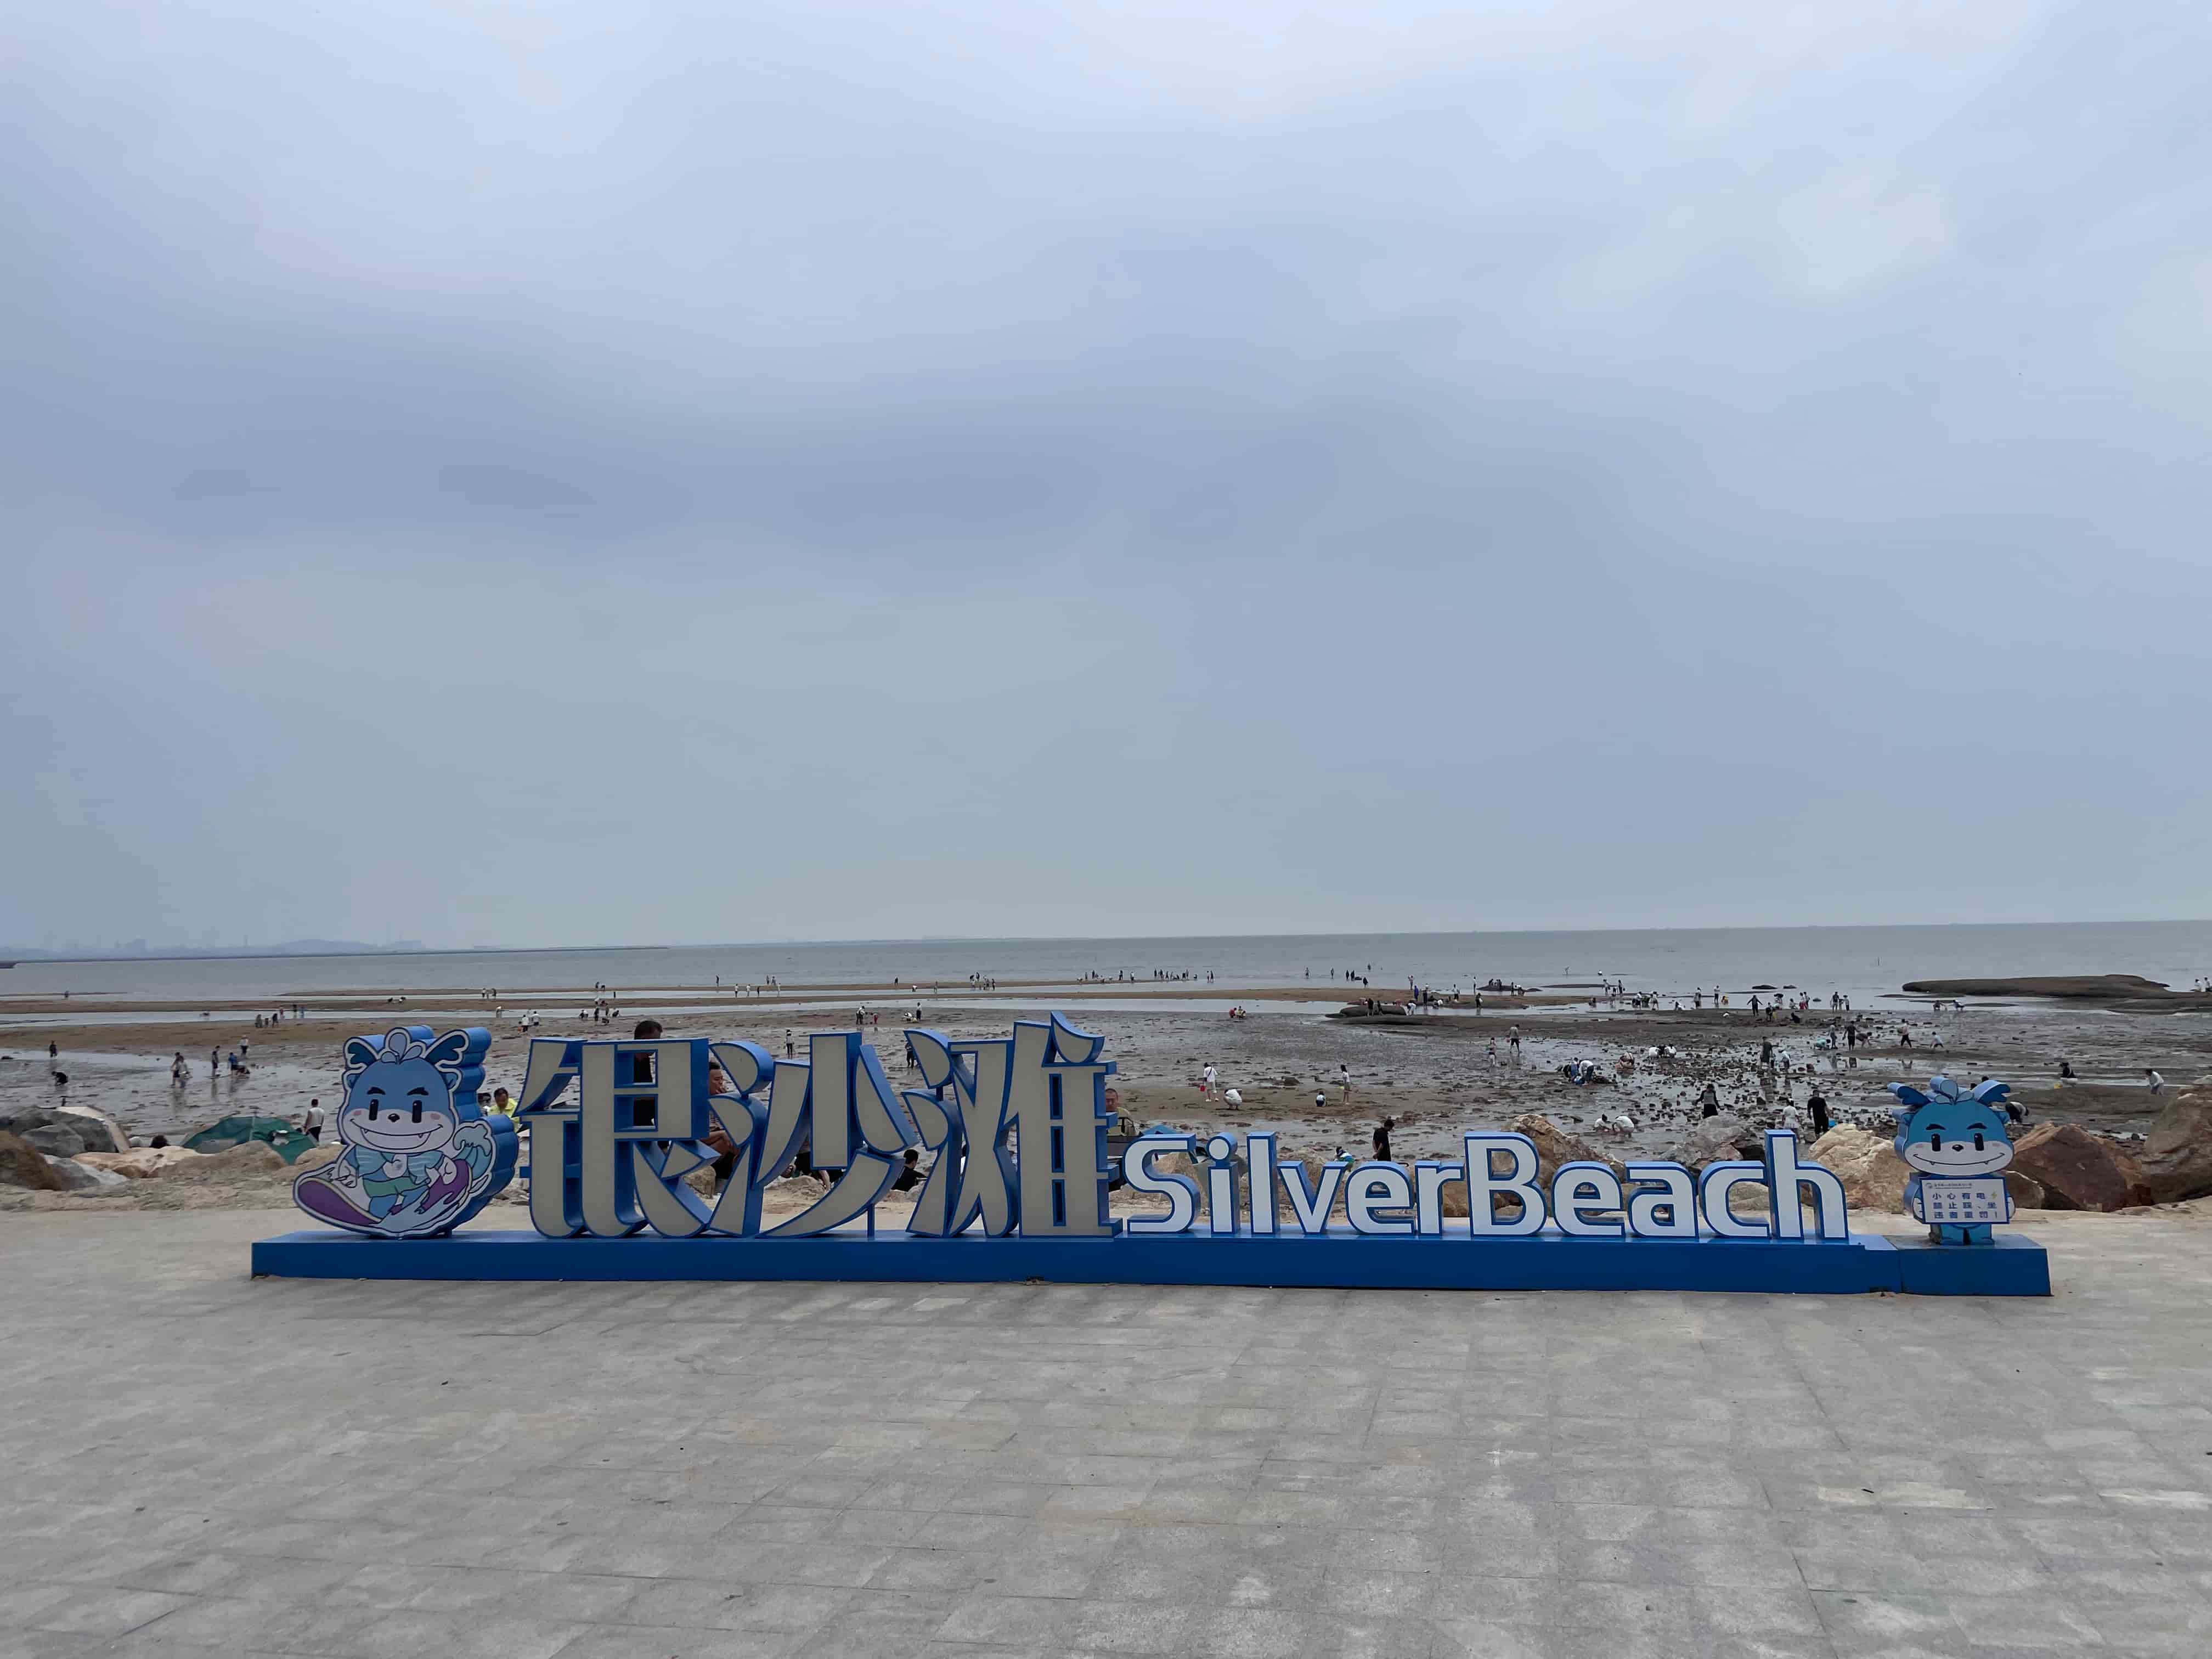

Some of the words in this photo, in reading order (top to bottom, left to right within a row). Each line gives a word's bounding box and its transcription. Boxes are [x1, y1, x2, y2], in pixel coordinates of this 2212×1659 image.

[517, 1011, 1122, 1238] 银沙滩
[1124, 1128, 1849, 1239] SilverBeach
[1932, 1192, 1985, 1200] 小心有电
